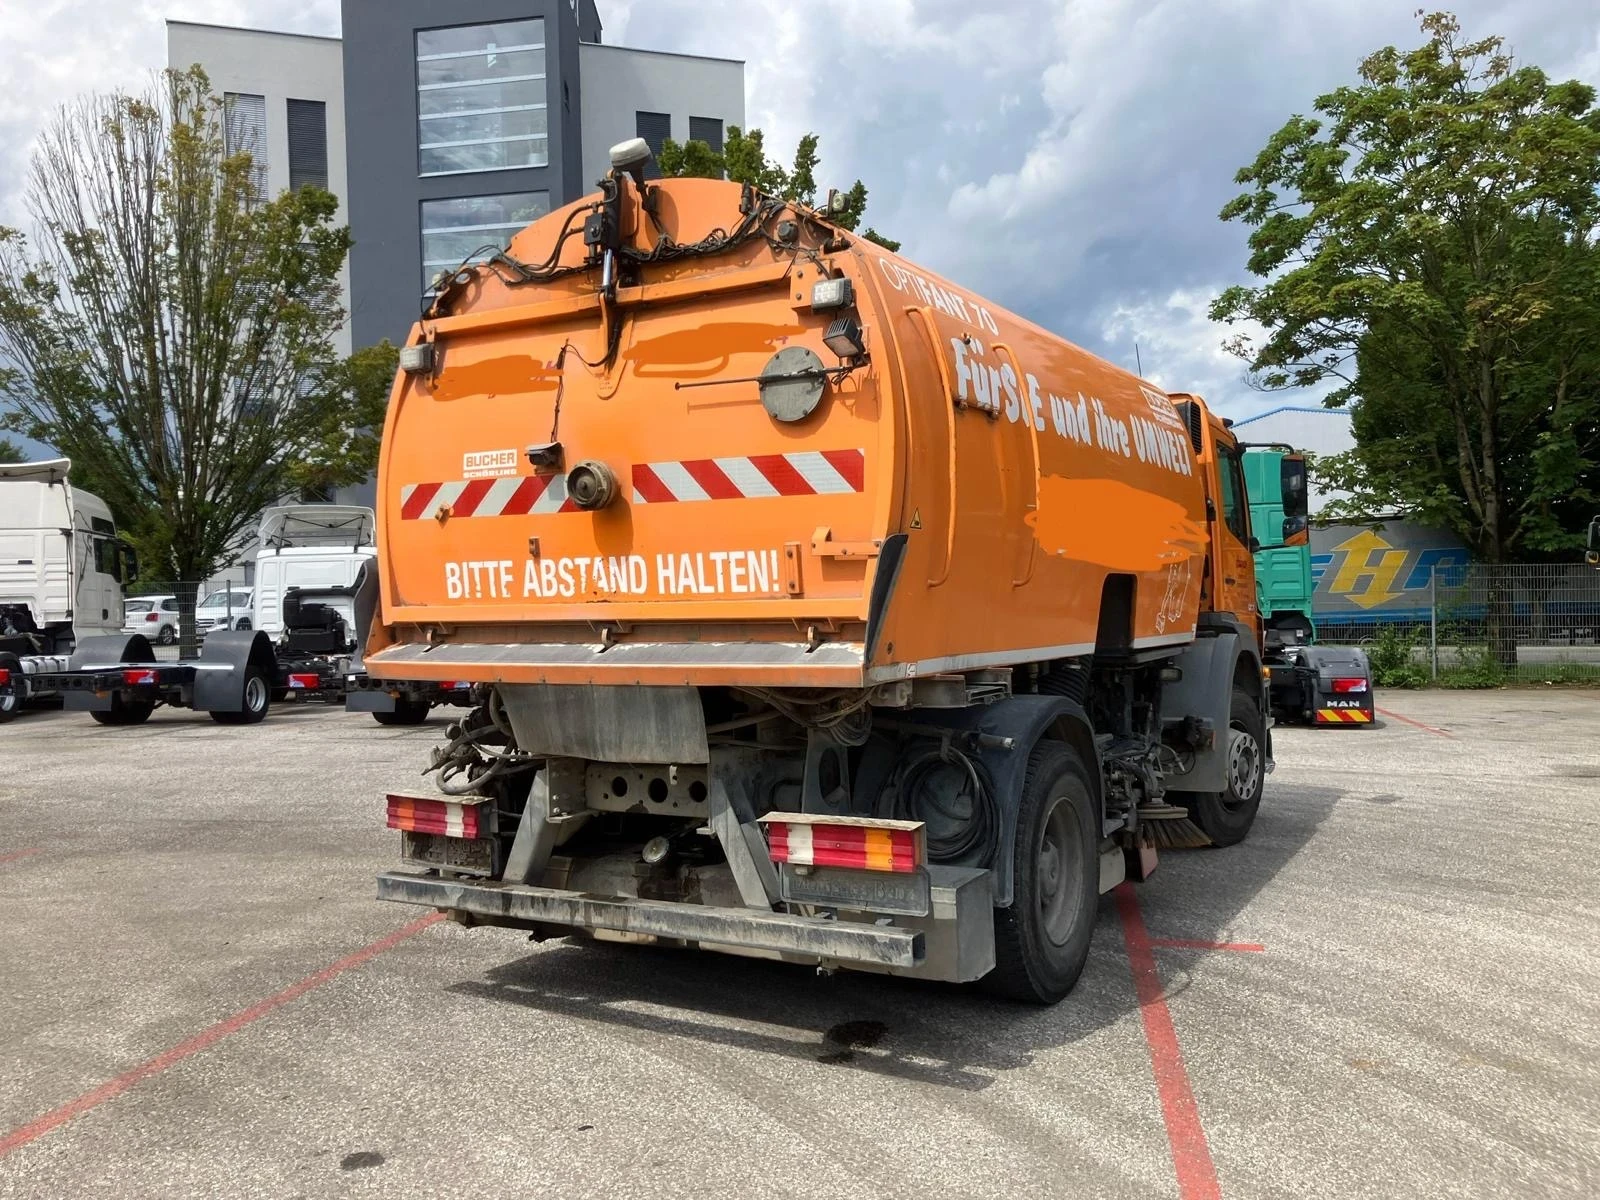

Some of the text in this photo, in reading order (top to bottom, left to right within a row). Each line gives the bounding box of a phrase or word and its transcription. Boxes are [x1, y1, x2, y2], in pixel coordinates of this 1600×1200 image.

[880, 258, 999, 336] OPTIFANT 70
[465, 452, 515, 467] BUCHER
[1049, 392, 1092, 446] und
[1091, 396, 1131, 458] ihre
[1129, 414, 1192, 477] UMWELT
[445, 550, 779, 599] BITTE ABSTAND HALTEN!
